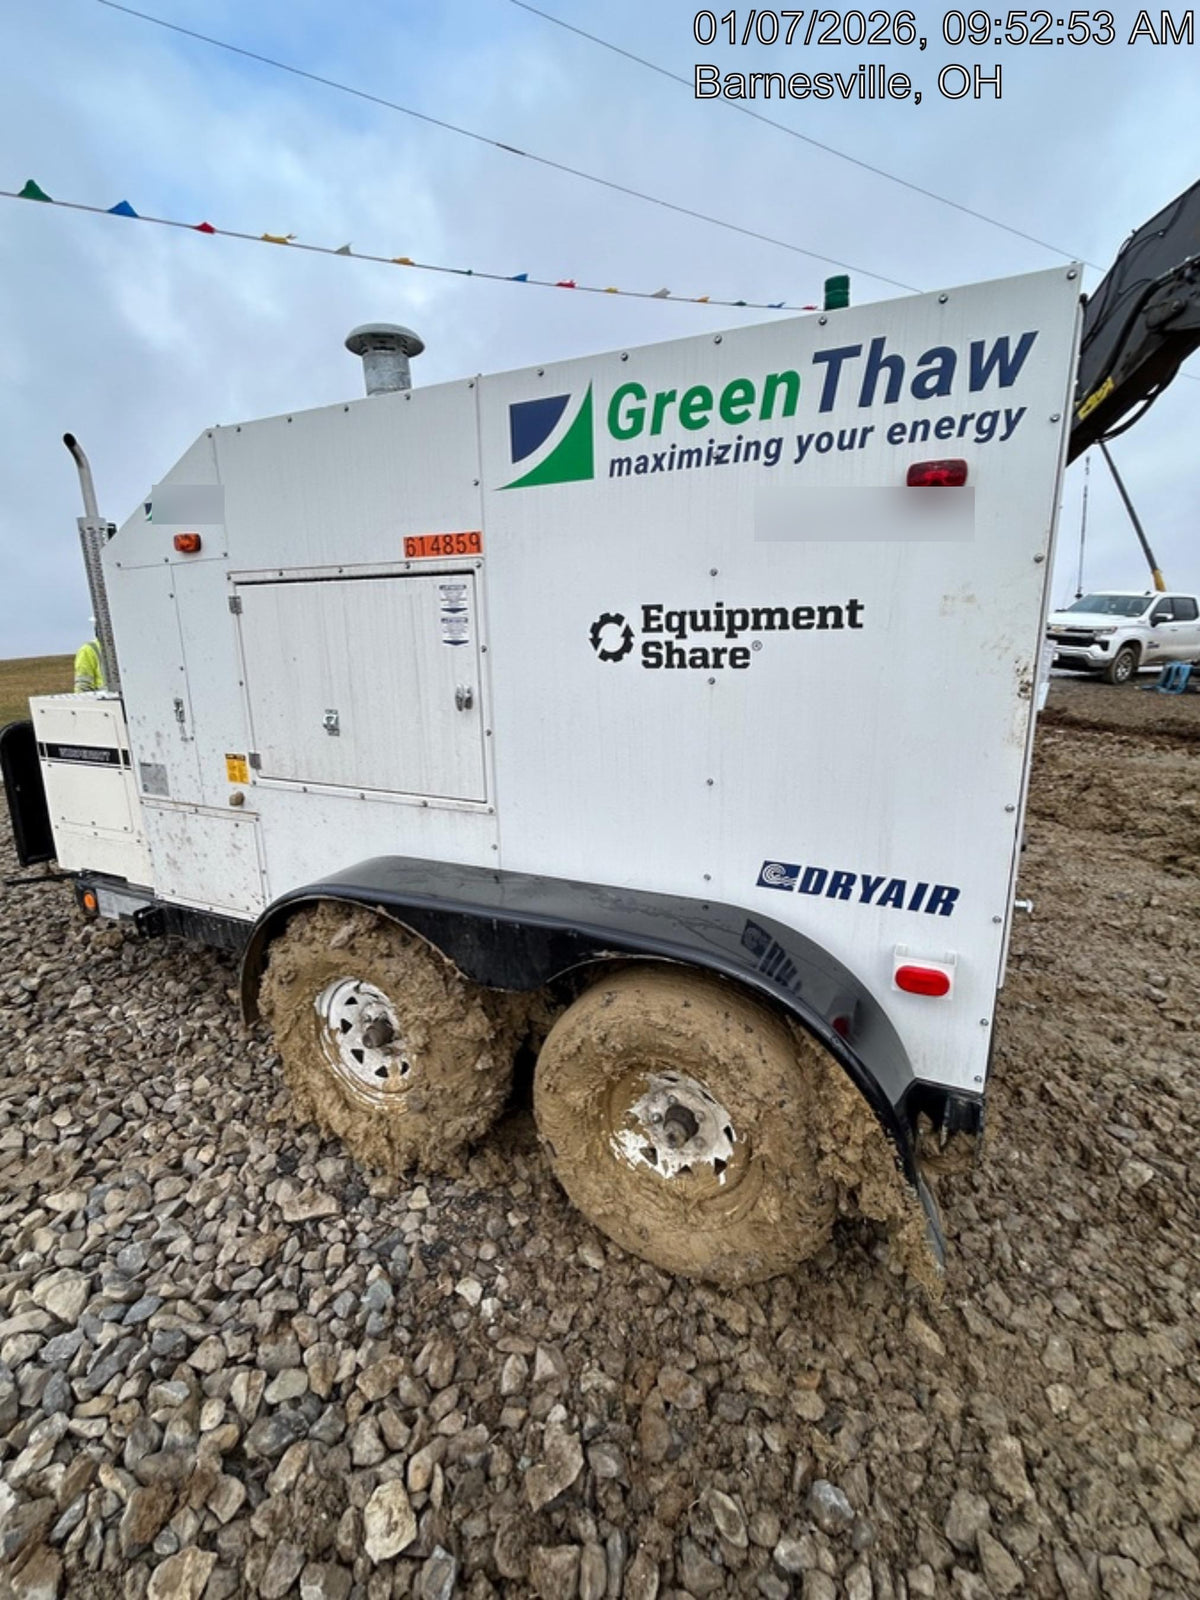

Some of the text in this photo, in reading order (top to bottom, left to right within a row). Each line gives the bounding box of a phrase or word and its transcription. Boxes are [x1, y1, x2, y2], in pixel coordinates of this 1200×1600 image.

[609, 406, 1028, 479] maximizing your energy
[405, 531, 481, 558] 614859
[641, 598, 864, 639] Equipment
[798, 865, 961, 917] DRYAIR
